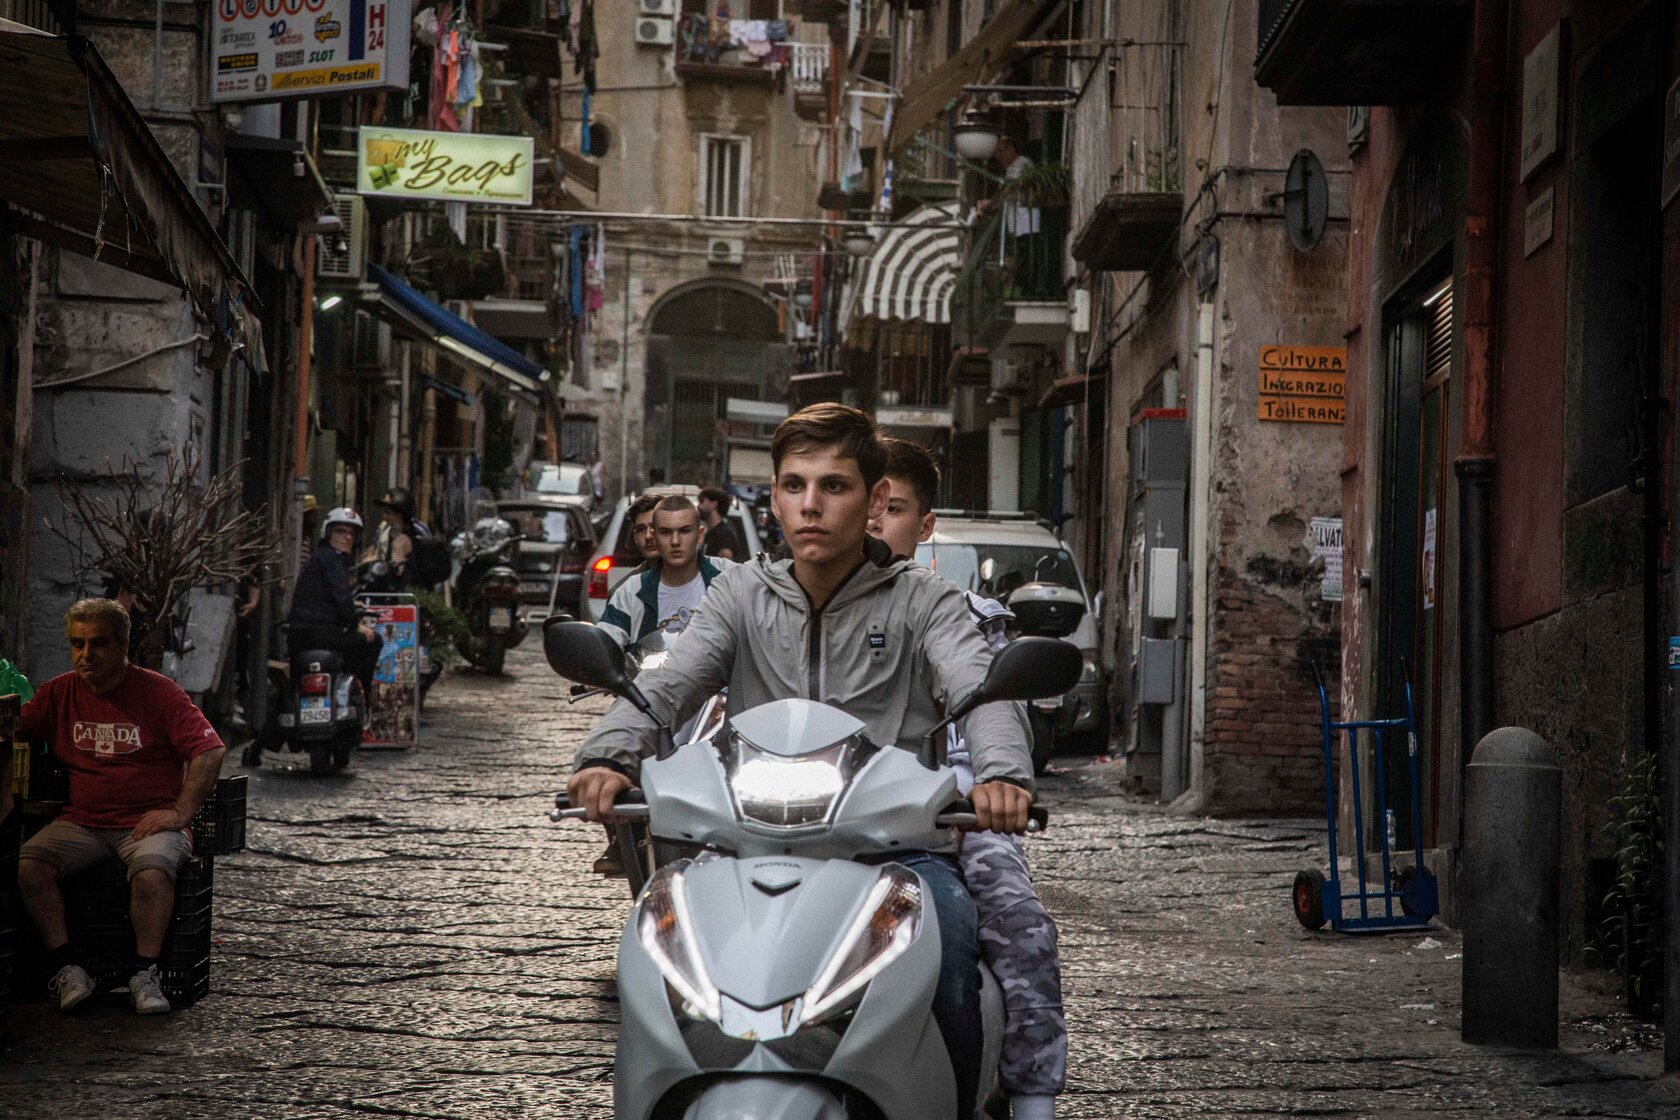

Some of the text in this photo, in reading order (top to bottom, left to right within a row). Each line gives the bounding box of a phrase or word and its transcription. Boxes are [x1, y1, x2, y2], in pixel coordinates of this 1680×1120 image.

[368, 4, 385, 29] H
[268, 20, 287, 38] 10
[368, 29, 385, 51] 24
[308, 49, 336, 63] SLOT
[329, 68, 375, 82] Postali
[395, 138, 437, 161] my
[404, 153, 528, 190] Bags
[73, 723, 143, 749] CANADA
